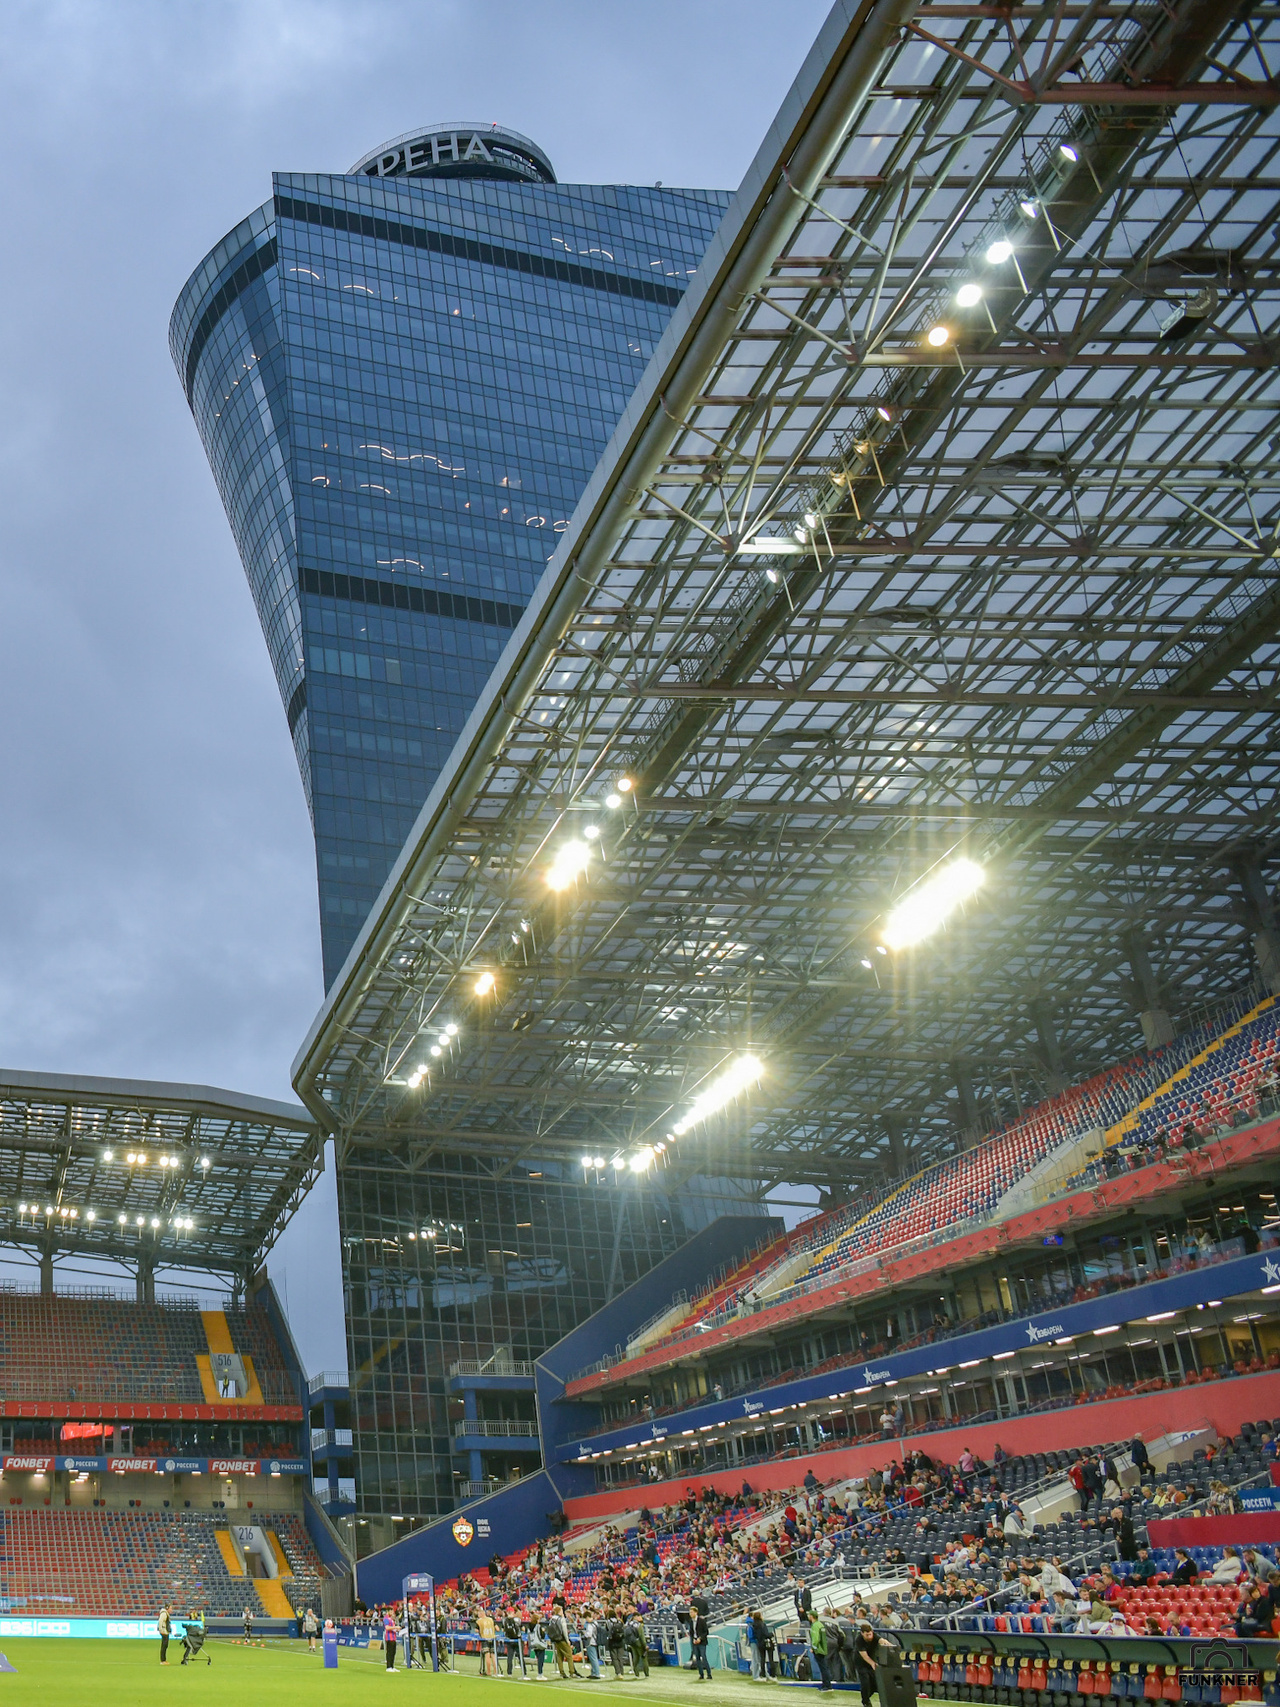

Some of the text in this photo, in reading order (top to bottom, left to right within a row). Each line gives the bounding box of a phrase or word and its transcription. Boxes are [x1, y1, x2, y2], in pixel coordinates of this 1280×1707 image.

[361, 132, 494, 176] РЕНА
[218, 1354, 231, 1366] 516
[5, 1457, 52, 1468] FONBET
[110, 1459, 156, 1470] FONBET
[211, 1460, 257, 1471] FONBET
[1242, 1497, 1272, 1509] РОССЕТИ
[239, 1527, 254, 1540] 216
